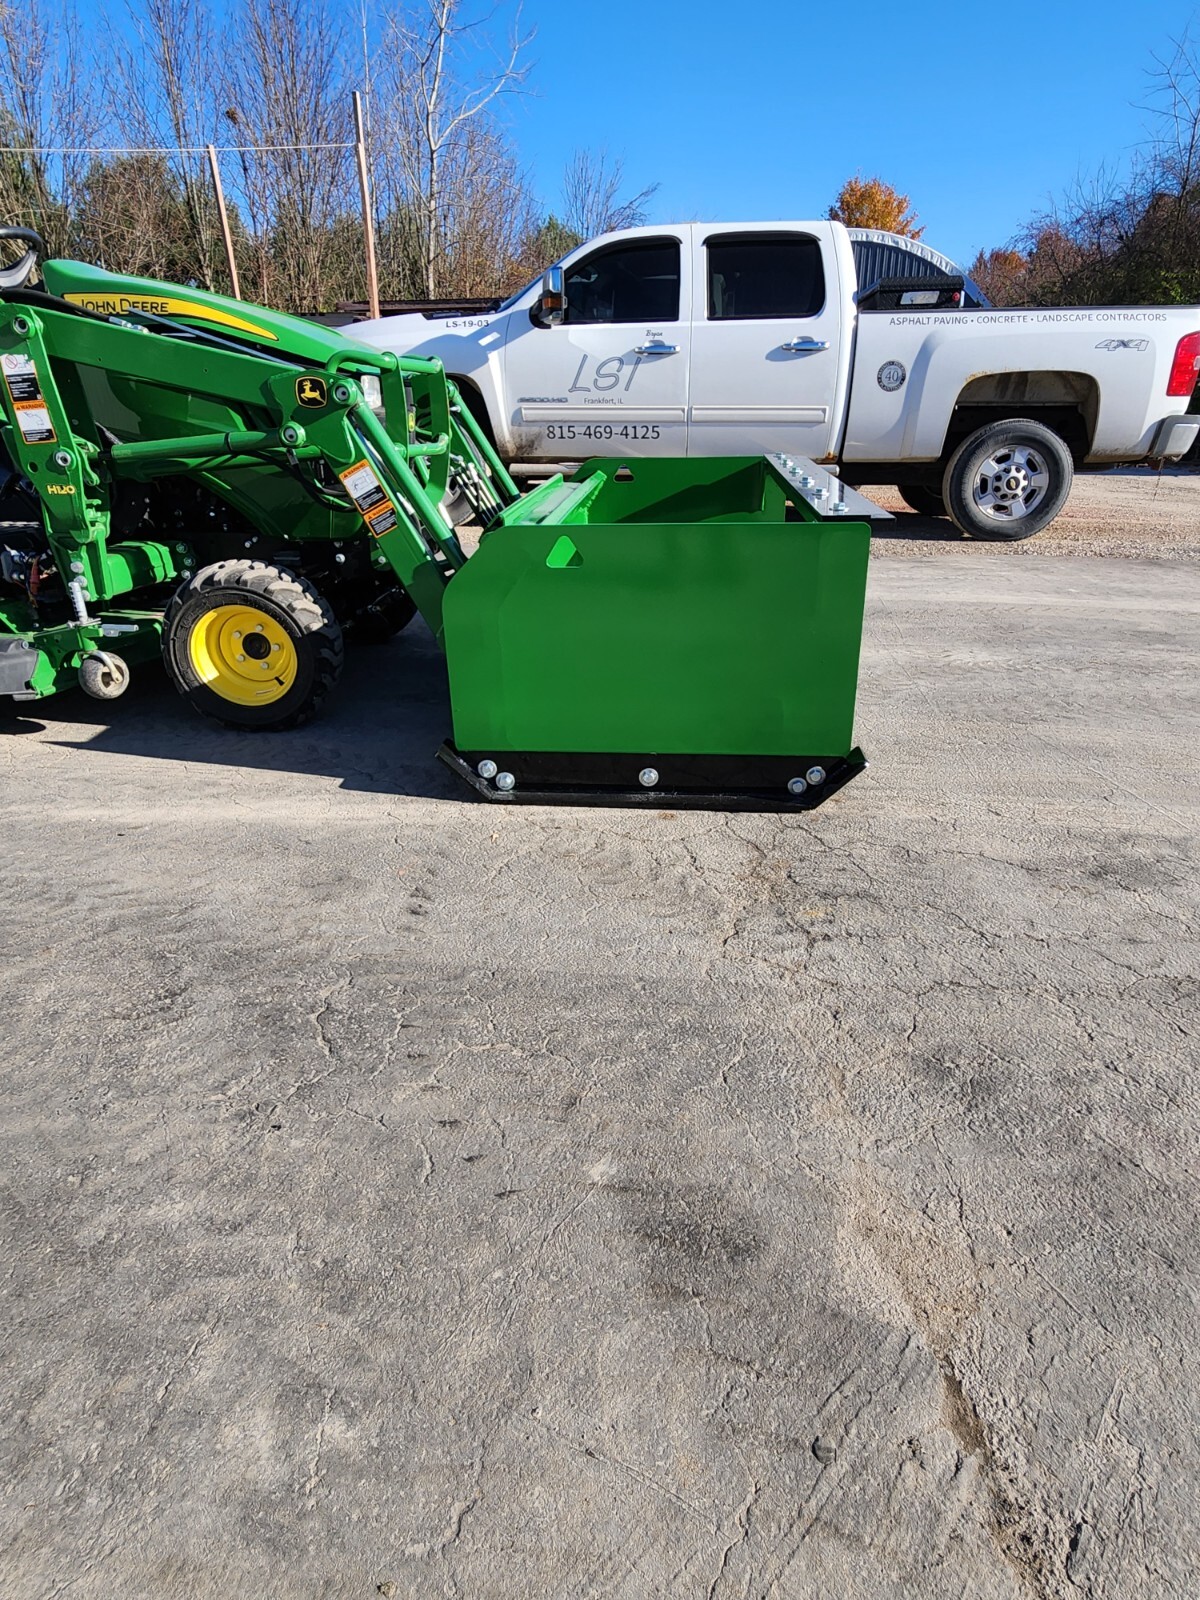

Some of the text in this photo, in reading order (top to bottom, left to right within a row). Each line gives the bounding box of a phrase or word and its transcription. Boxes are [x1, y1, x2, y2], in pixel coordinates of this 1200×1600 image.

[81, 298, 169, 313] JOHN DEERE
[445, 319, 490, 328] LS-19-03
[889, 312, 1168, 326] ASPHALT PAVING CONCRETE LANDSCAPE CONTRACTORS
[568, 353, 642, 393] LSI
[884, 370, 899, 382] 40
[583, 397, 616, 405] Frankfort,
[546, 424, 661, 440] 815-469-4125
[46, 484, 76, 496] H120
